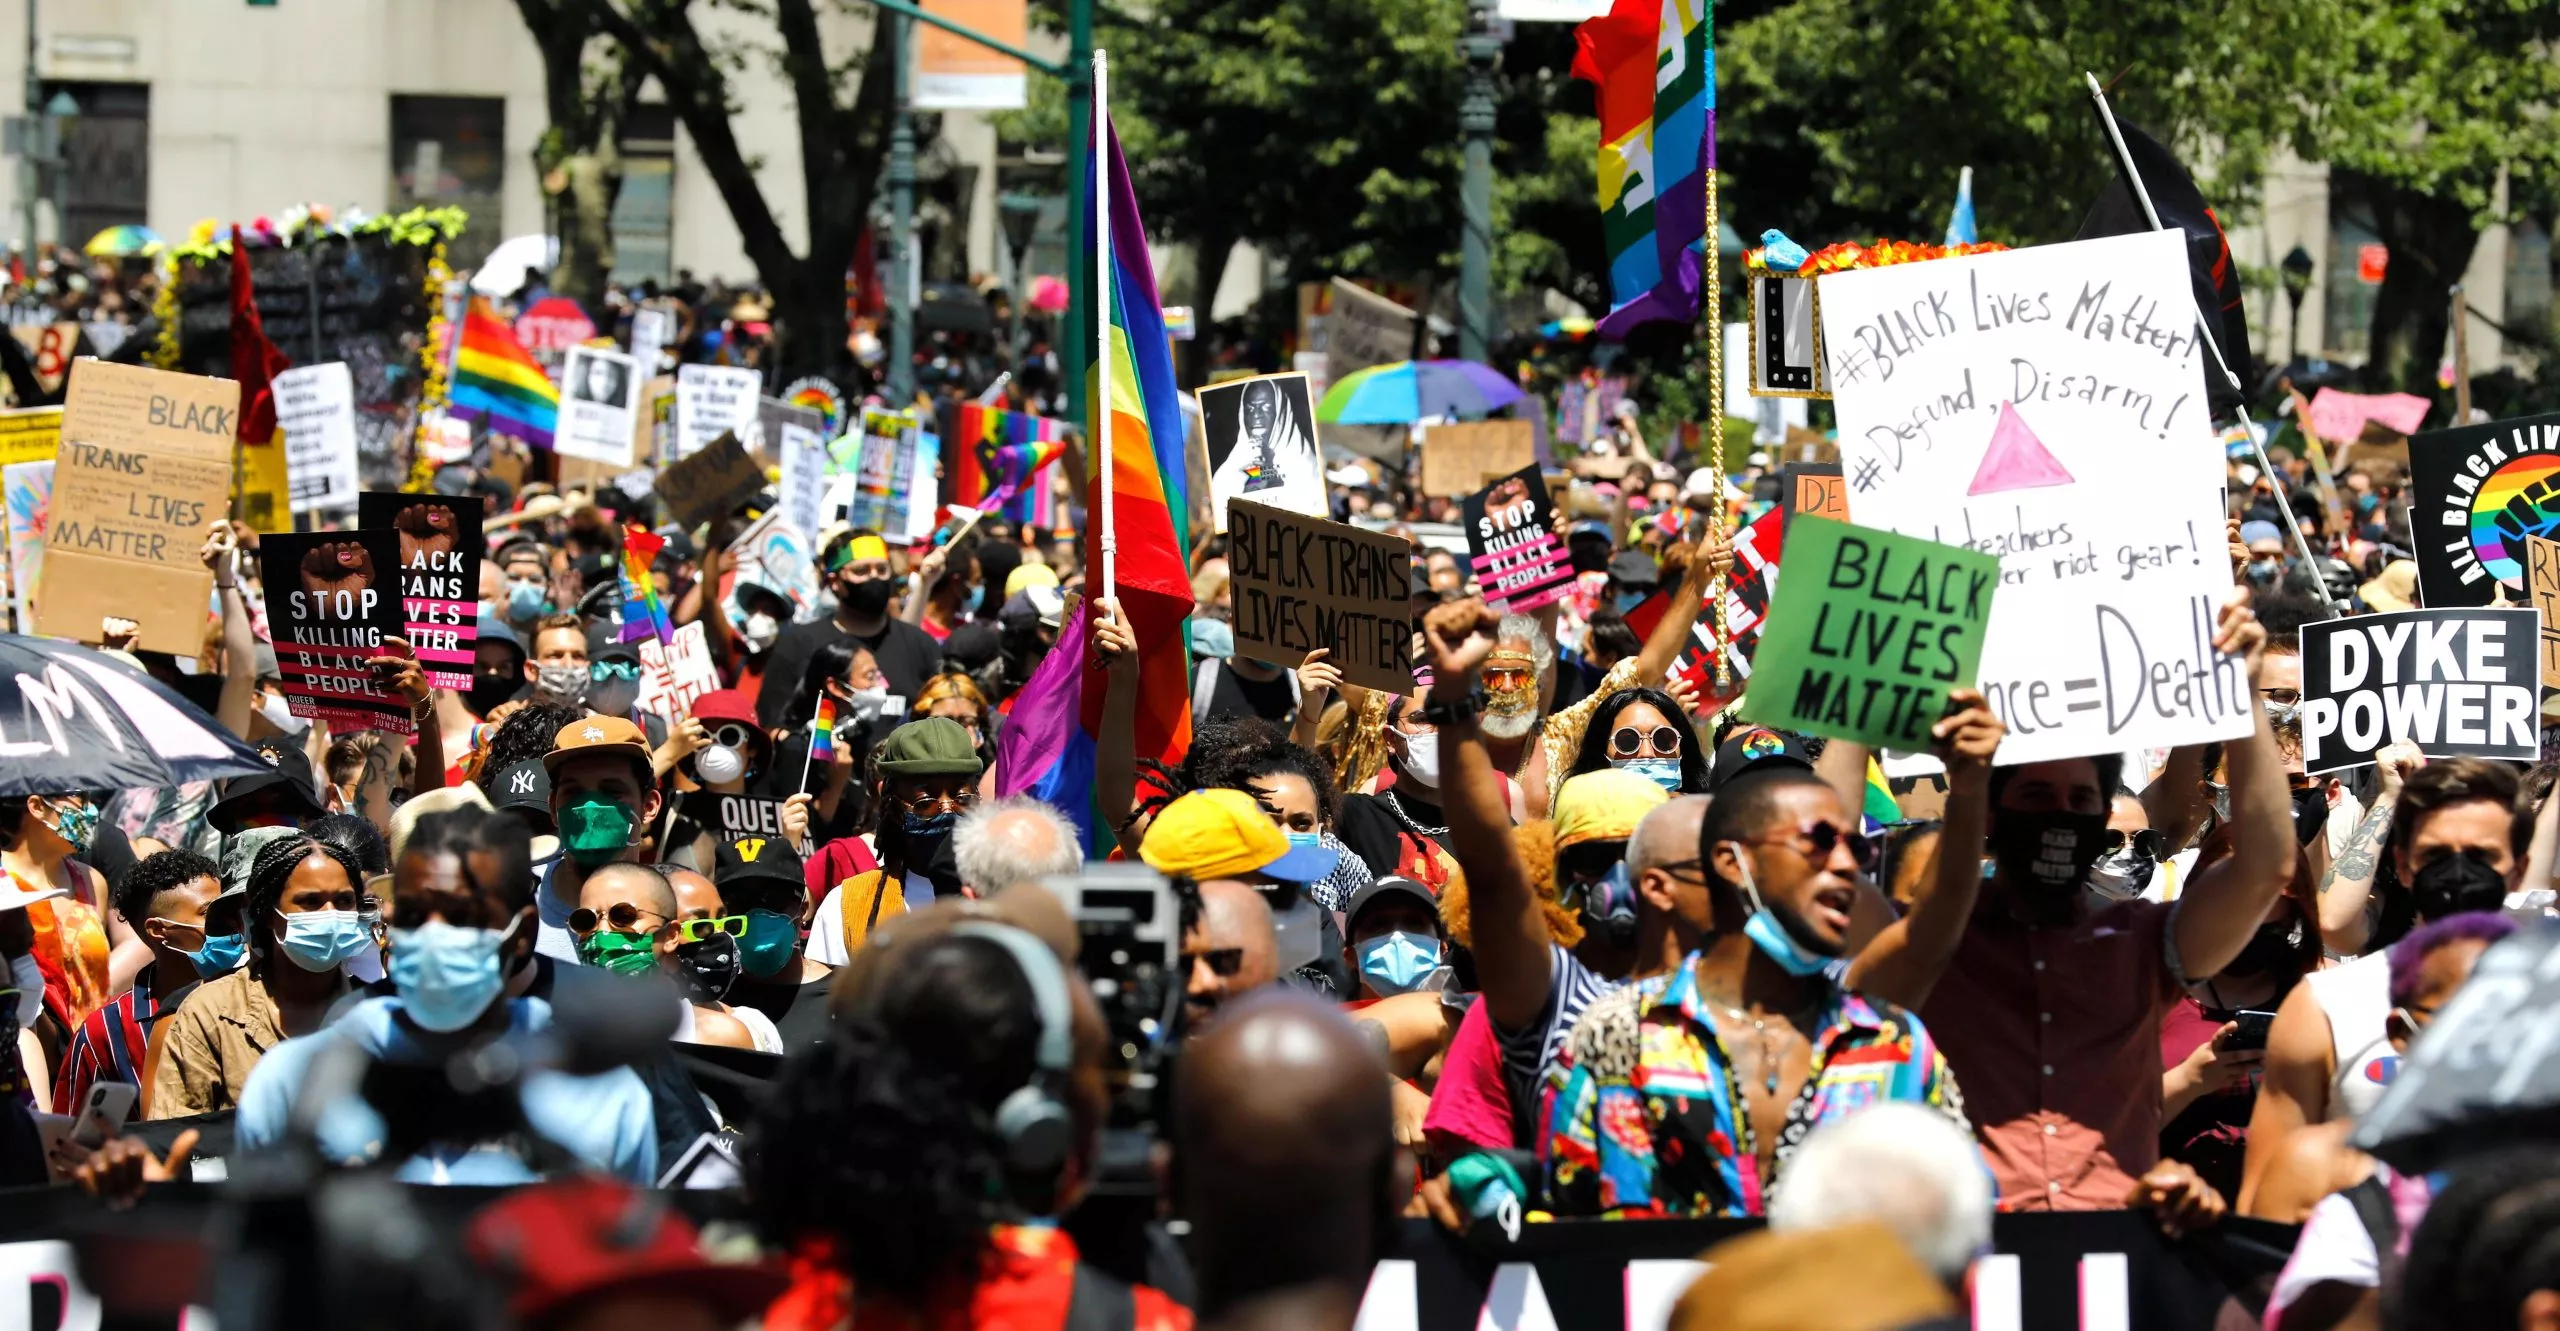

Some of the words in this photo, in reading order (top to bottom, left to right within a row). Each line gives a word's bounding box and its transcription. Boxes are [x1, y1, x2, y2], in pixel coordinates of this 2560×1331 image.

[1970, 268, 2051, 331] Lives
[2066, 280, 2201, 369] Matter!
[147, 395, 234, 436] BLACK
[2010, 357, 2188, 440] Disarm!
[71, 439, 149, 475] TRANS
[2442, 437, 2509, 527] BLACK
[127, 492, 206, 527] LIVES
[1479, 500, 1536, 538] STOP
[53, 522, 168, 561] MATTER
[1483, 524, 1545, 556] KILLING
[1962, 505, 2073, 558] teachers
[2052, 540, 2098, 580] riot
[2117, 520, 2201, 581] gear!
[401, 549, 463, 573] ACK
[1230, 508, 1315, 589] BLACK
[1318, 534, 1411, 602] TRANS
[1490, 541, 1553, 575] BLACK
[2445, 536, 2487, 586] ALL
[1496, 561, 1558, 593] PEOPLE
[1828, 535, 1988, 622] BLACK
[290, 588, 378, 621] STOP
[294, 626, 381, 649] KILLING
[1233, 581, 1310, 653] LIVES
[1316, 604, 1414, 676] MATTER
[1810, 601, 1964, 683] LIVES
[2330, 619, 2507, 694] DYKE
[435, 671, 472, 681] SUNDAY
[288, 694, 316, 706] QUEER
[291, 708, 319, 718] MARCH
[373, 711, 410, 726] SUNDAY
[1791, 667, 1956, 740] MATTE
[373, 718, 397, 731] JUNE
[399, 723, 410, 734] 28
[2302, 683, 2536, 762] POWER
[734, 838, 766, 863] V
